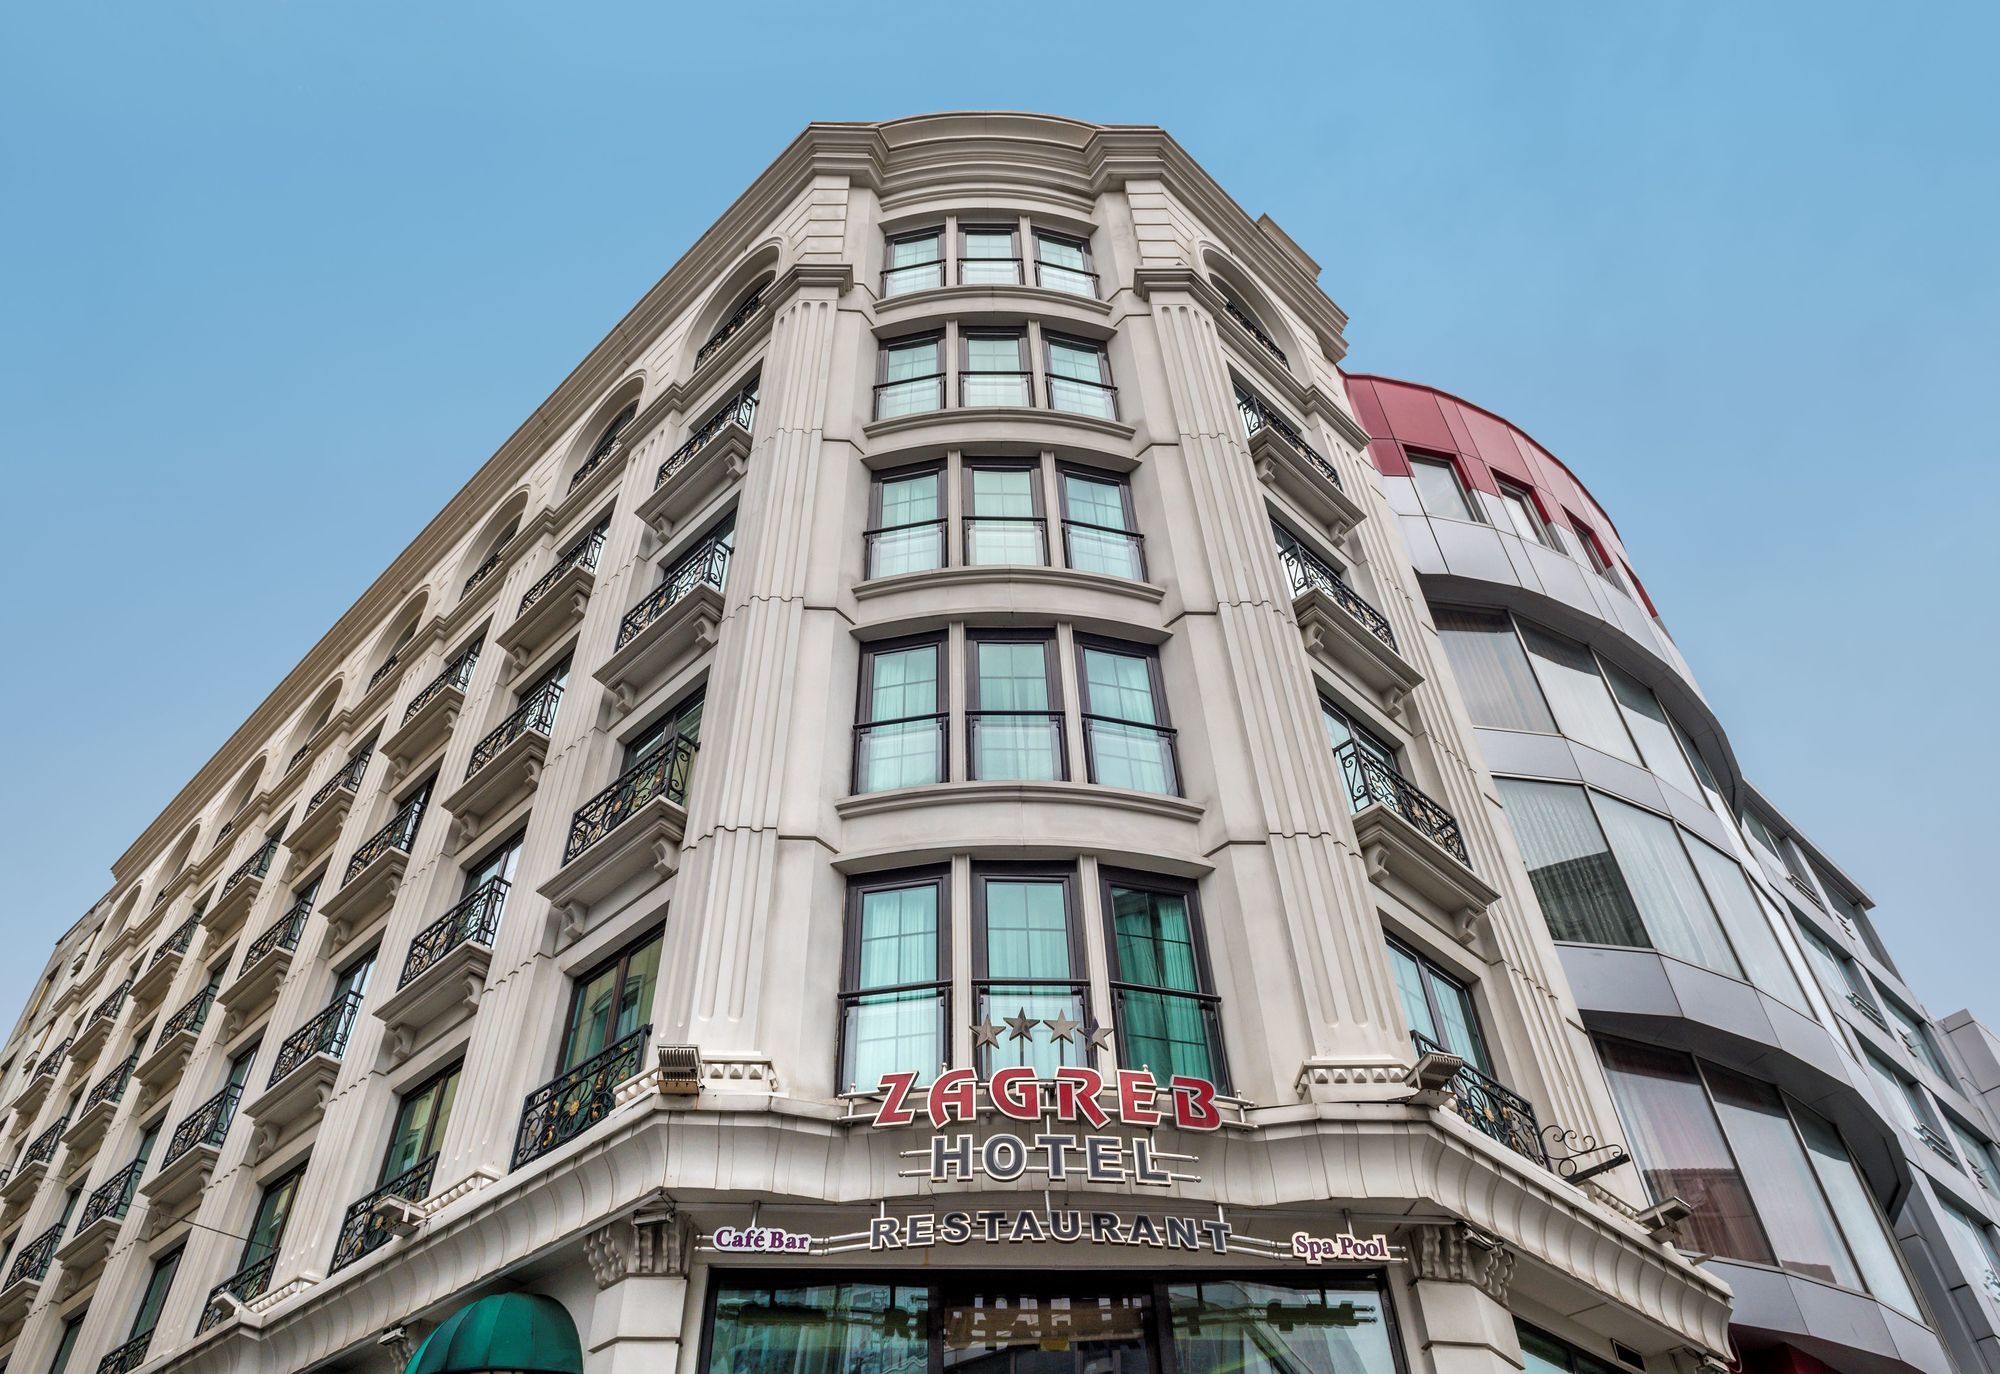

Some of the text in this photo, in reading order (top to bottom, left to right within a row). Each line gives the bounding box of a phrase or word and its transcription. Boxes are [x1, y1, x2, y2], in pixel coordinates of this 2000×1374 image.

[872, 1066, 1223, 1131] ZAGREB
[930, 1133, 1172, 1186] HOTEL
[715, 1228, 809, 1250] Café Bar
[869, 1209, 1233, 1254] RESTAURANT
[1294, 1235, 1388, 1261] Spa Pool
